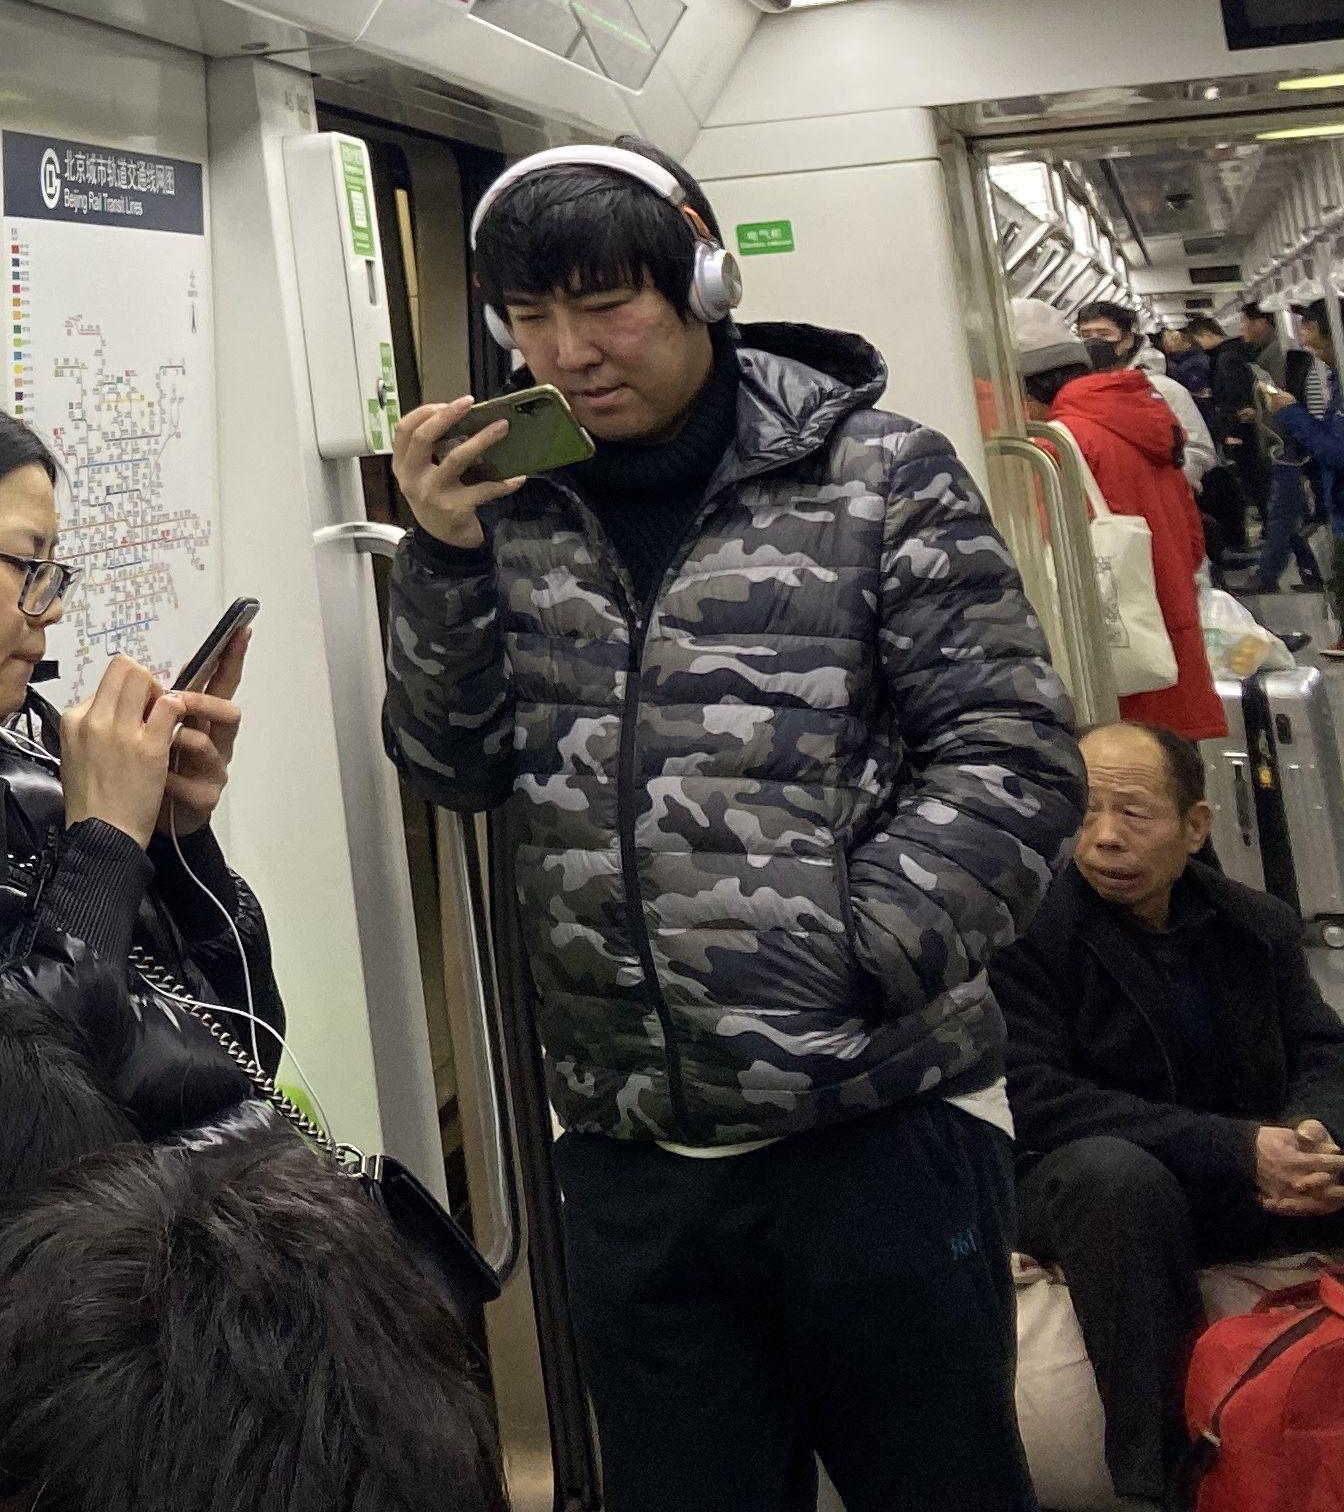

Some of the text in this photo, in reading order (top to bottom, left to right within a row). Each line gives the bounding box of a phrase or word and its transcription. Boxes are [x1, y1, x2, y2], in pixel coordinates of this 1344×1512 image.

[63, 187, 144, 217] Beijing Rail Transit Lines
